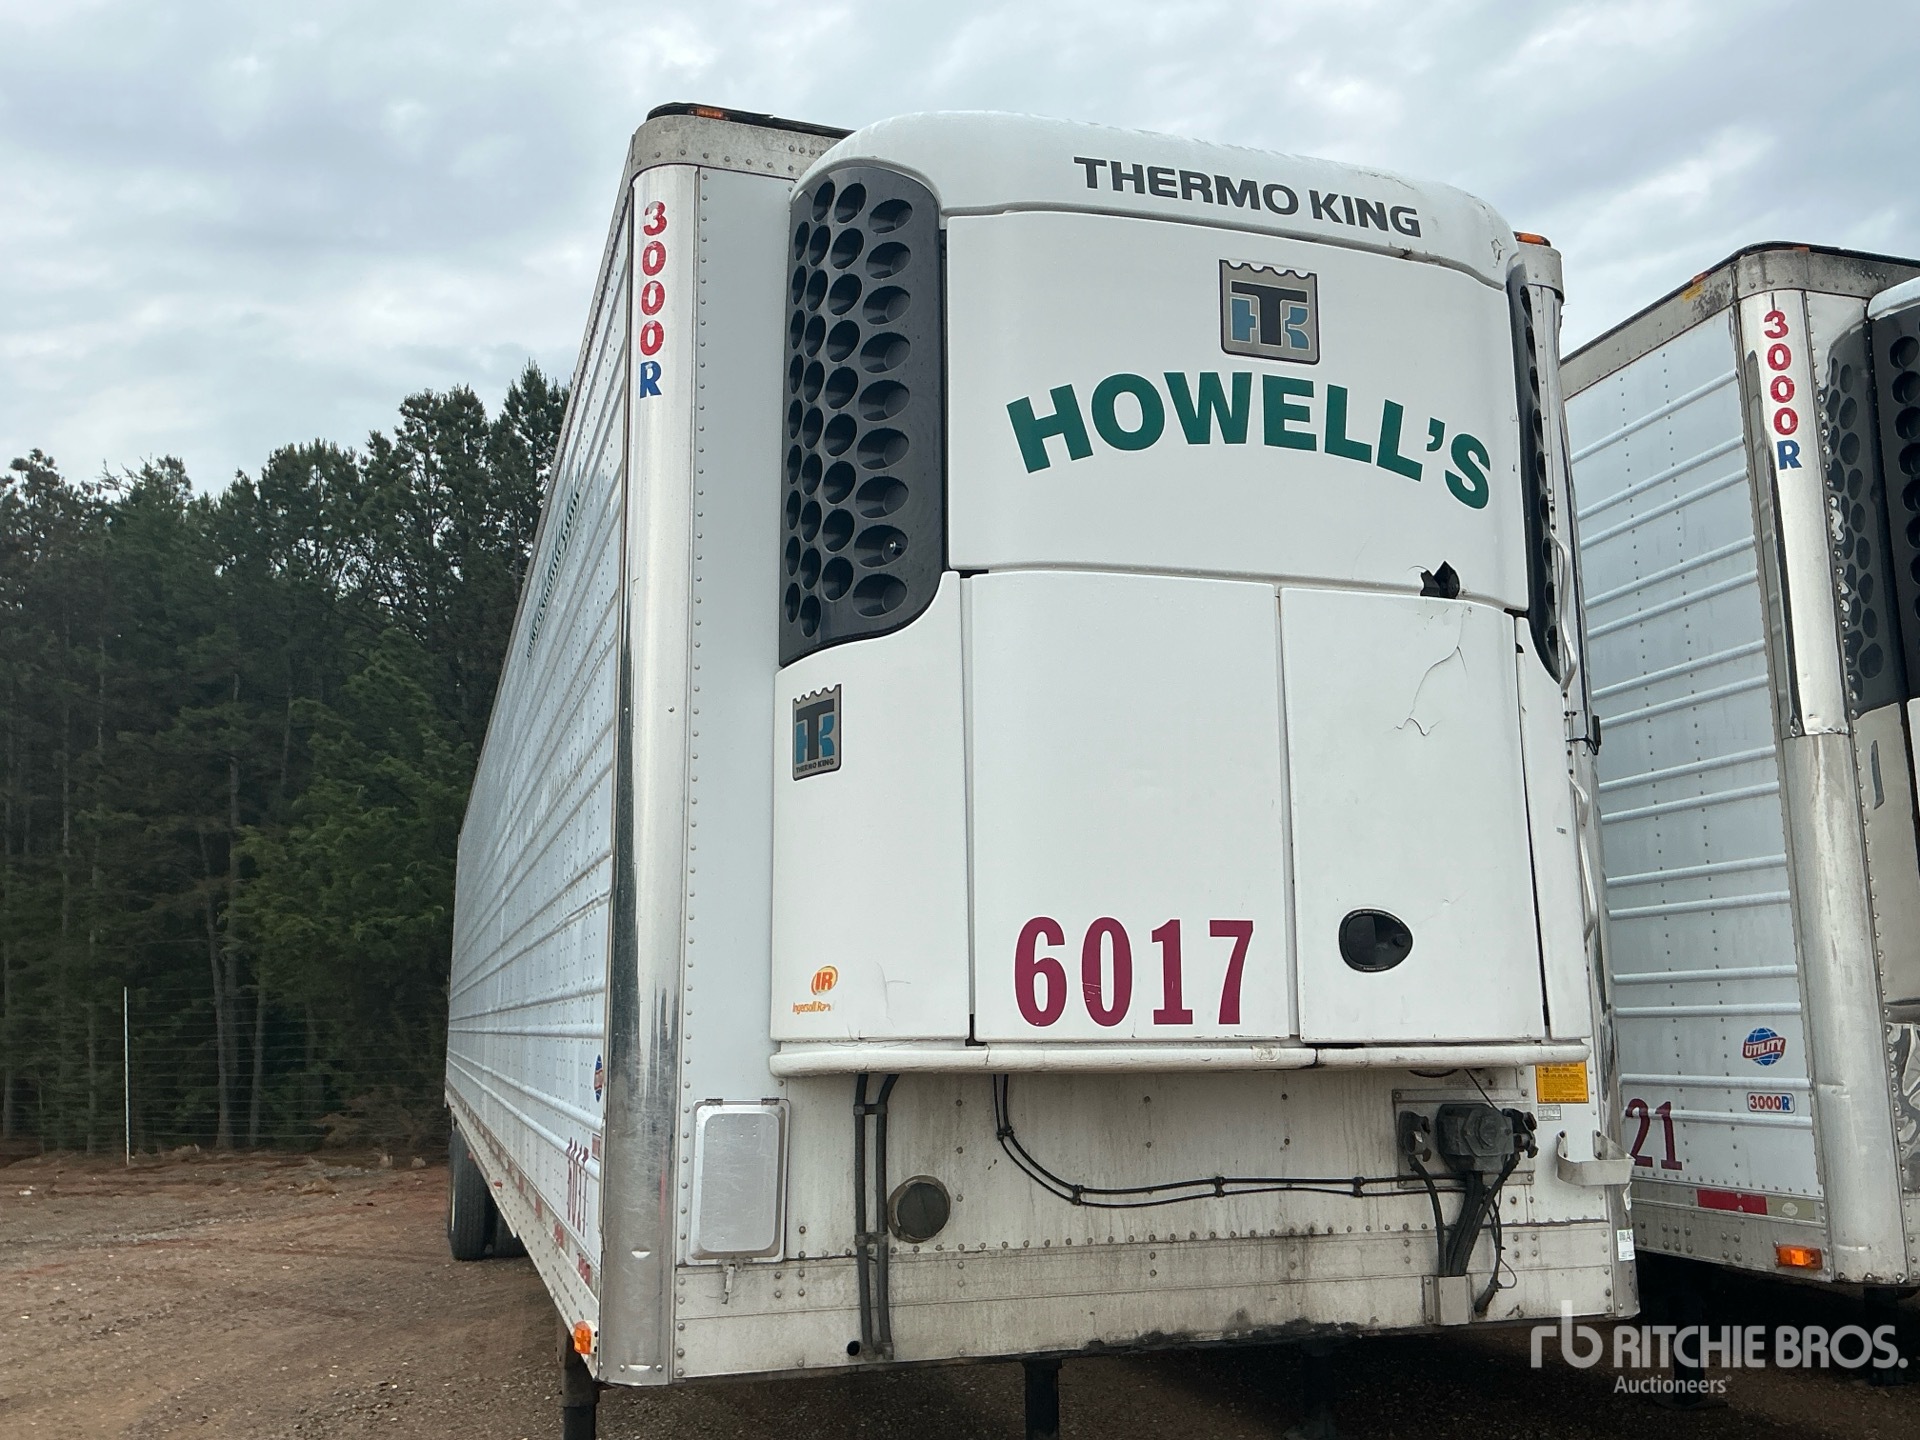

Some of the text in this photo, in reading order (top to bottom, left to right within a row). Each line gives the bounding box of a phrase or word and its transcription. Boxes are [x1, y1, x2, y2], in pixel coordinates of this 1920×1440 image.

[1074, 157, 1422, 238] THERMO KING
[640, 201, 667, 398] 3000R
[1764, 309, 1803, 471] 3000R
[1006, 371, 1491, 509] HOWELL'S
[796, 758, 834, 773] THERMO KING
[815, 971, 833, 990] IR
[1014, 916, 1254, 1027] 6017
[1745, 1039, 1783, 1057] UTILITY
[1750, 1094, 1790, 1111] 3000R
